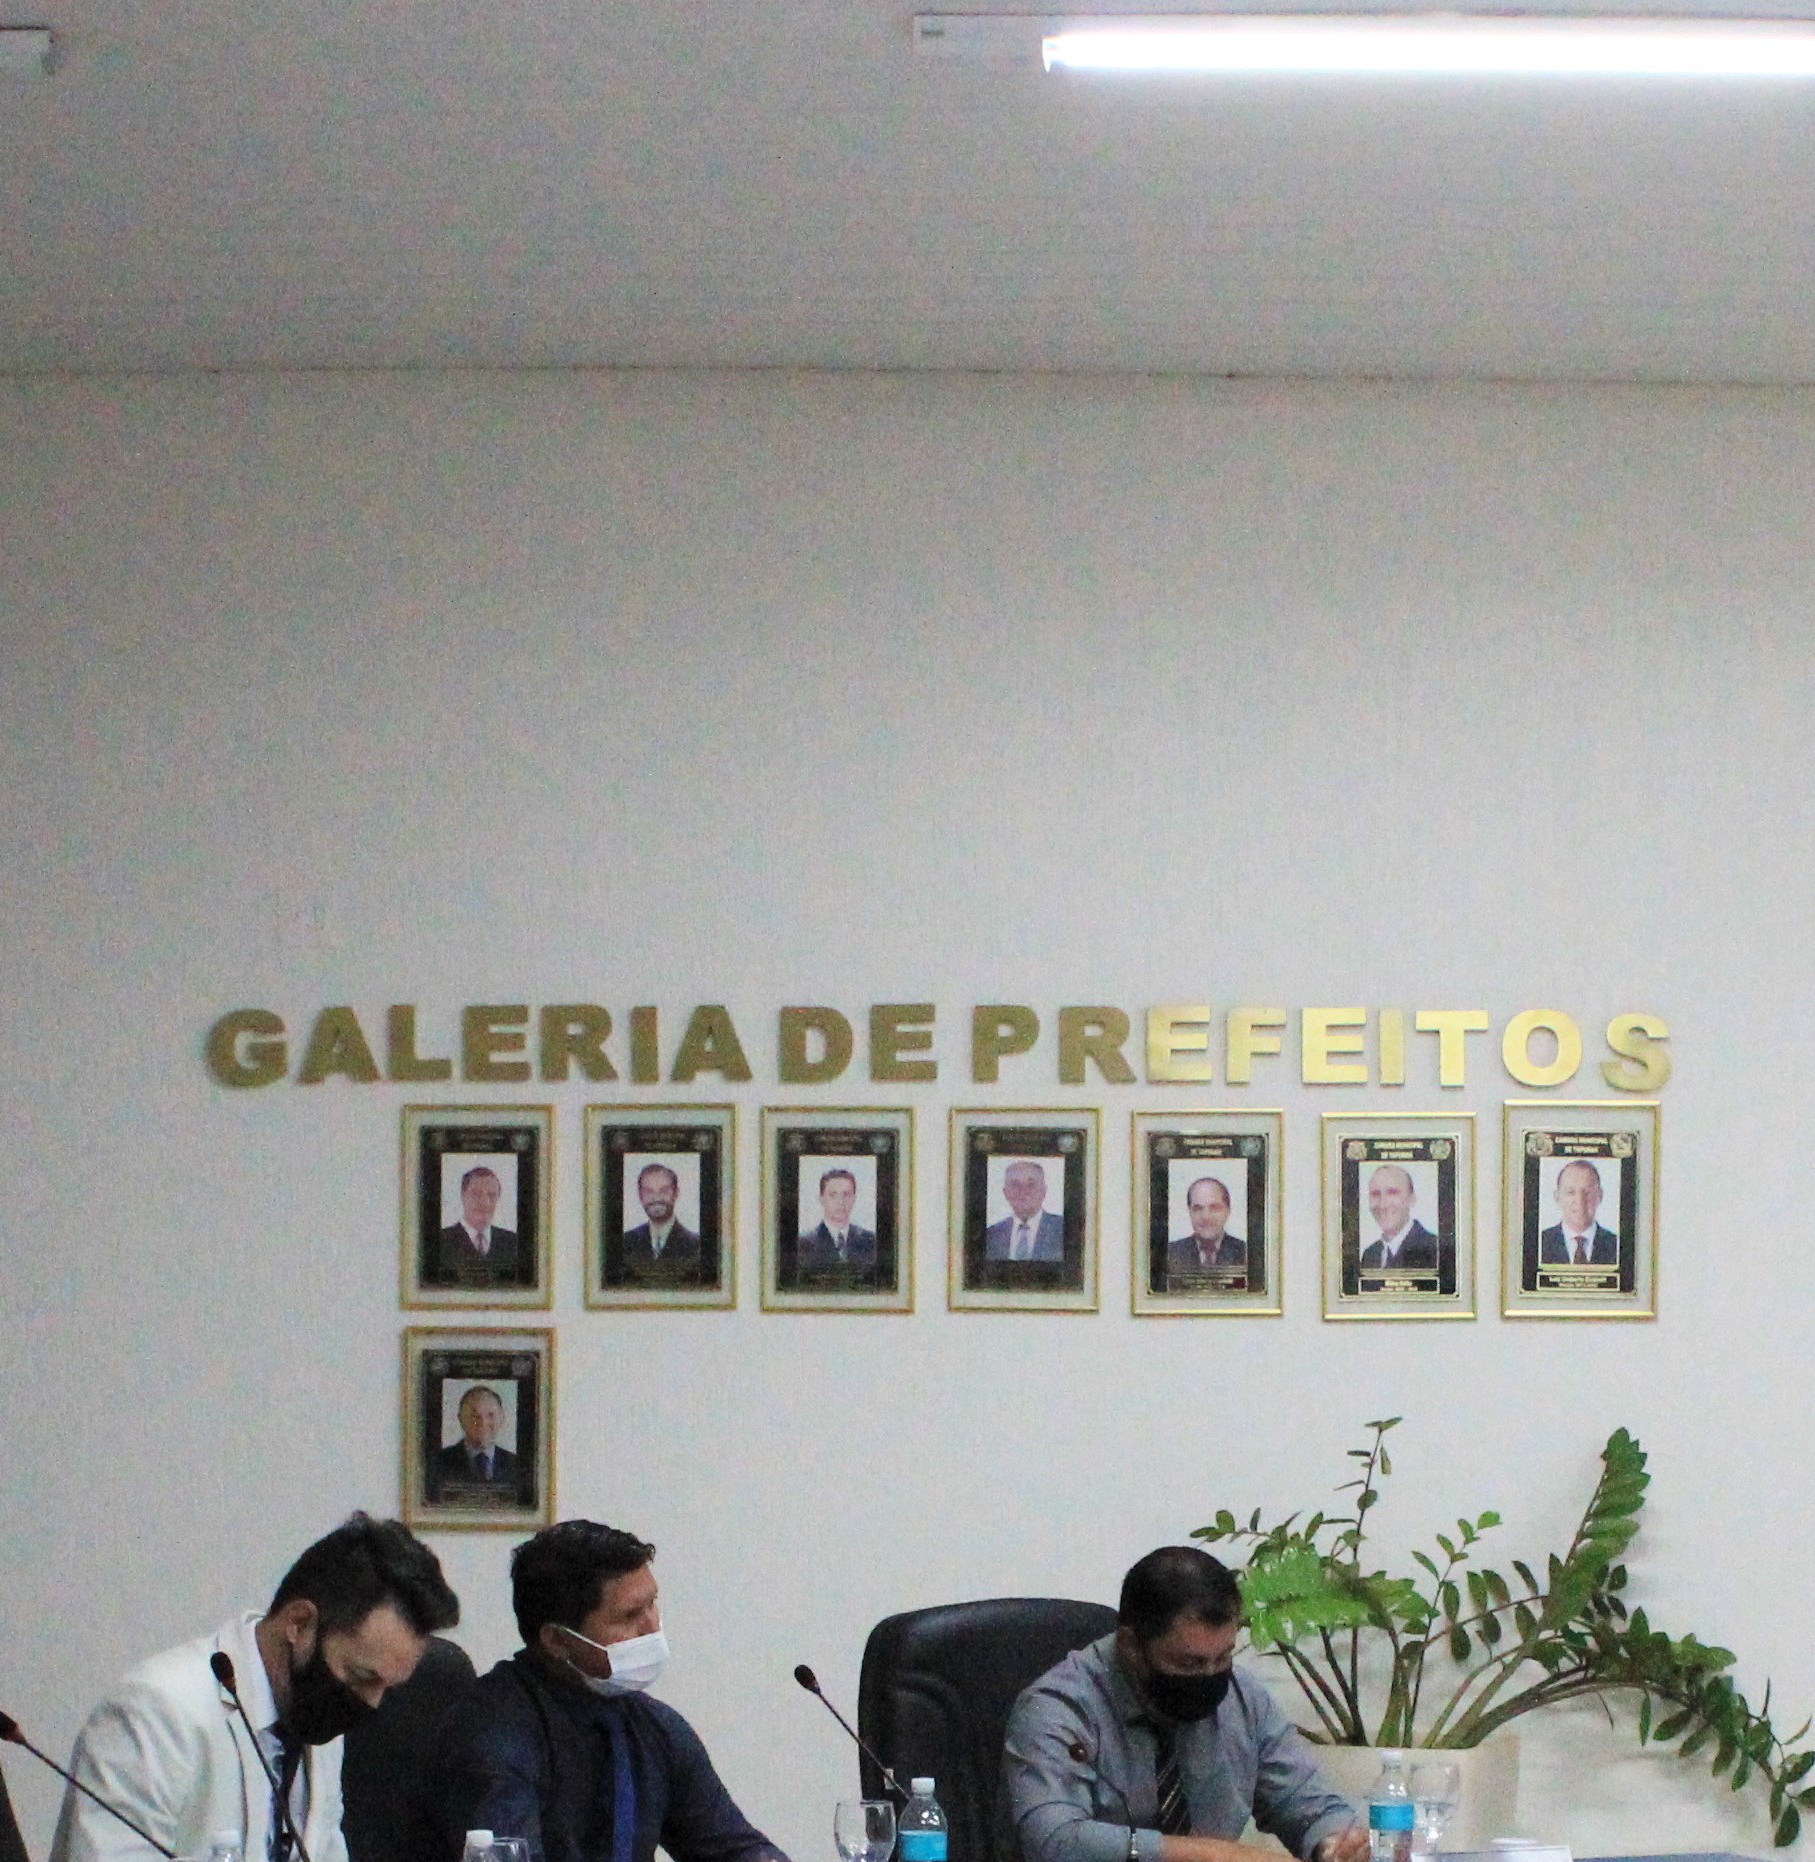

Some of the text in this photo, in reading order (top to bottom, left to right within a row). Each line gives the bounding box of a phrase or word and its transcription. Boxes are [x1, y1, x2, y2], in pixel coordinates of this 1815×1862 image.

[207, 1004, 1671, 1092] GALERIA DE PREFEITOS
